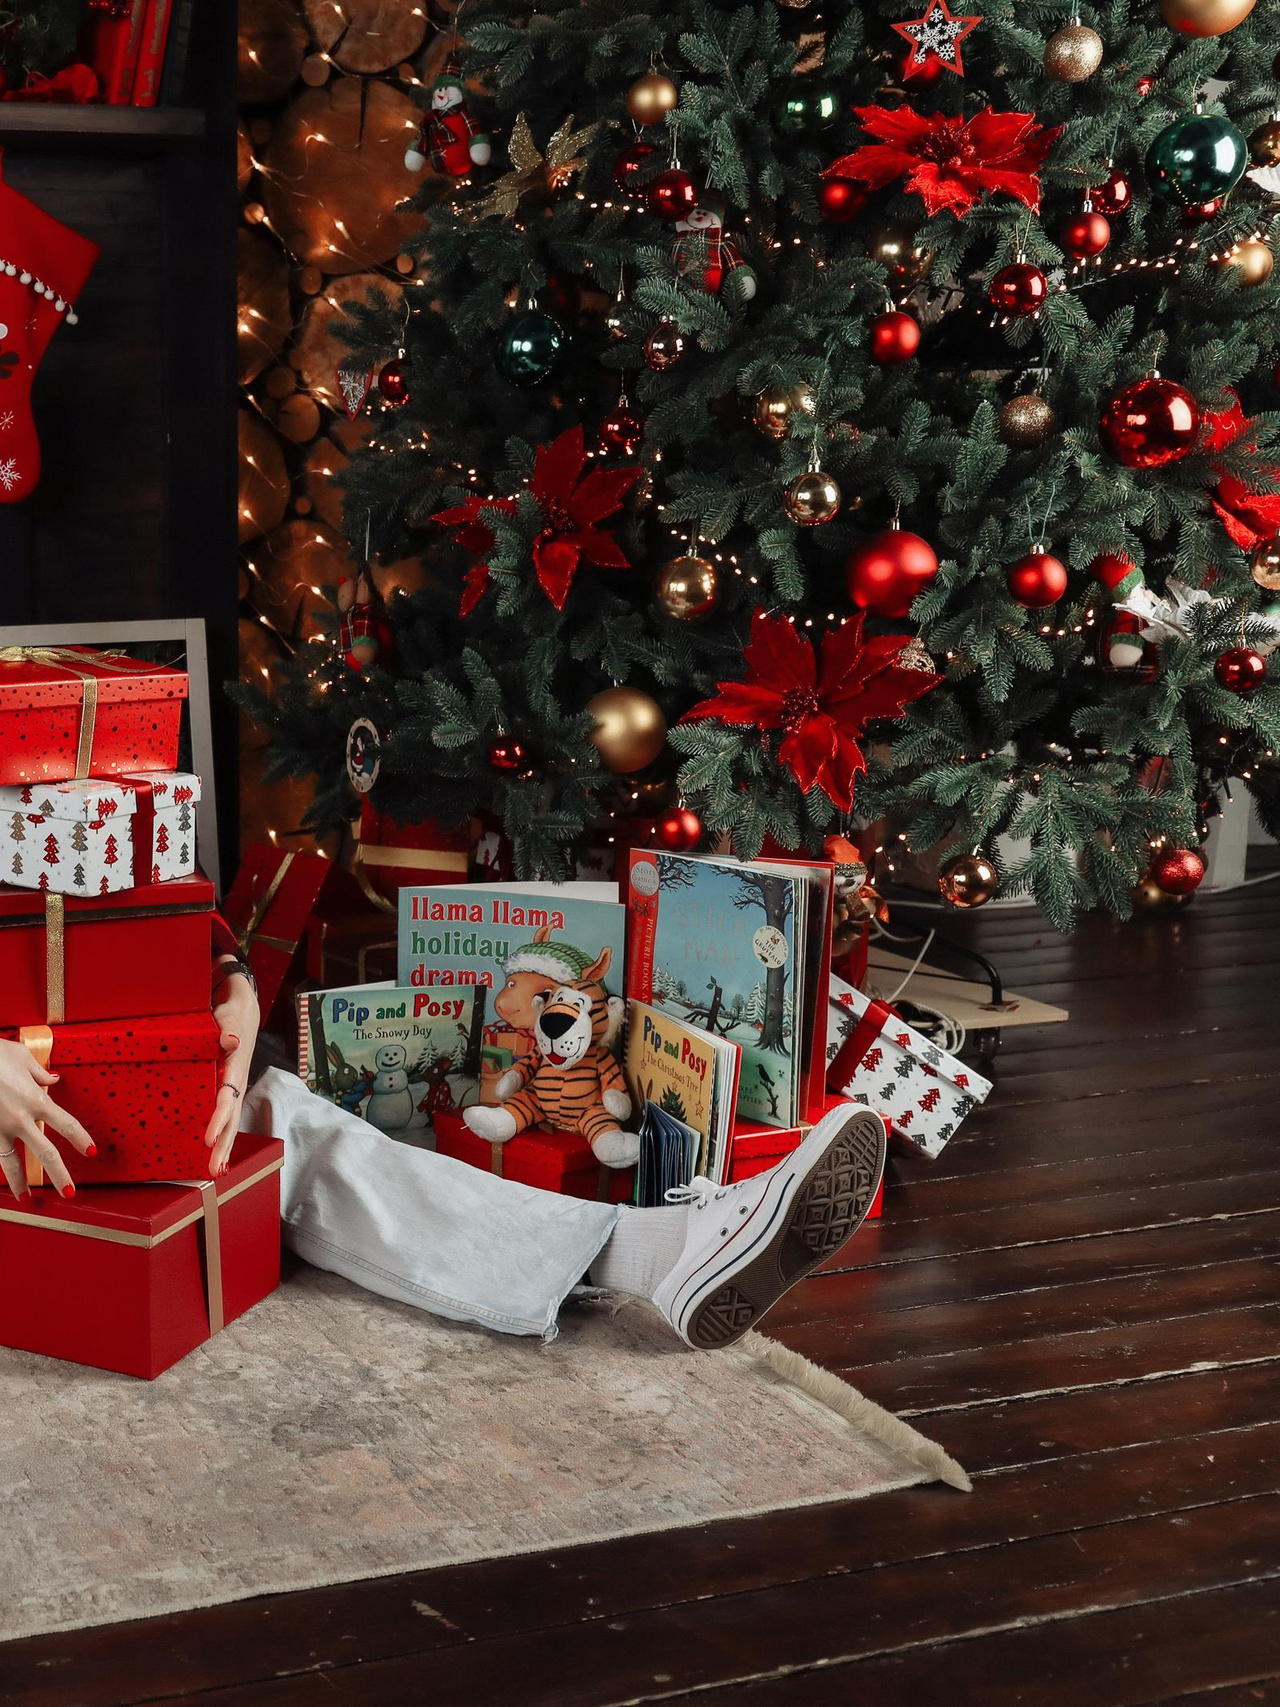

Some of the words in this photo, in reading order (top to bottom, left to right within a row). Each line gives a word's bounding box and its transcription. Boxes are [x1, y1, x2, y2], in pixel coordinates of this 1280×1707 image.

[635, 865, 656, 877] Story
[637, 882, 654, 894] Song
[411, 896, 484, 922] llama
[492, 899, 565, 929] llama
[411, 931, 510, 965] holiday
[643, 918, 654, 960] PICTURE
[683, 935, 740, 969] MAN
[754, 938, 782, 965] GRUFFALO
[765, 940, 776, 951] THE
[410, 963, 494, 989] drama
[332, 997, 370, 1026] Pip
[376, 1002, 406, 1019] and
[413, 993, 465, 1020] Posy
[353, 1028, 373, 1041] The
[374, 1027, 410, 1041] Snowy
[412, 1025, 433, 1040] Day
[643, 1015, 662, 1053] Pip
[663, 1039, 679, 1059] and
[681, 1037, 707, 1081] Posy
[646, 1051, 657, 1066] The
[657, 1058, 686, 1084] Christmas
[686, 1075, 699, 1092] Tree
